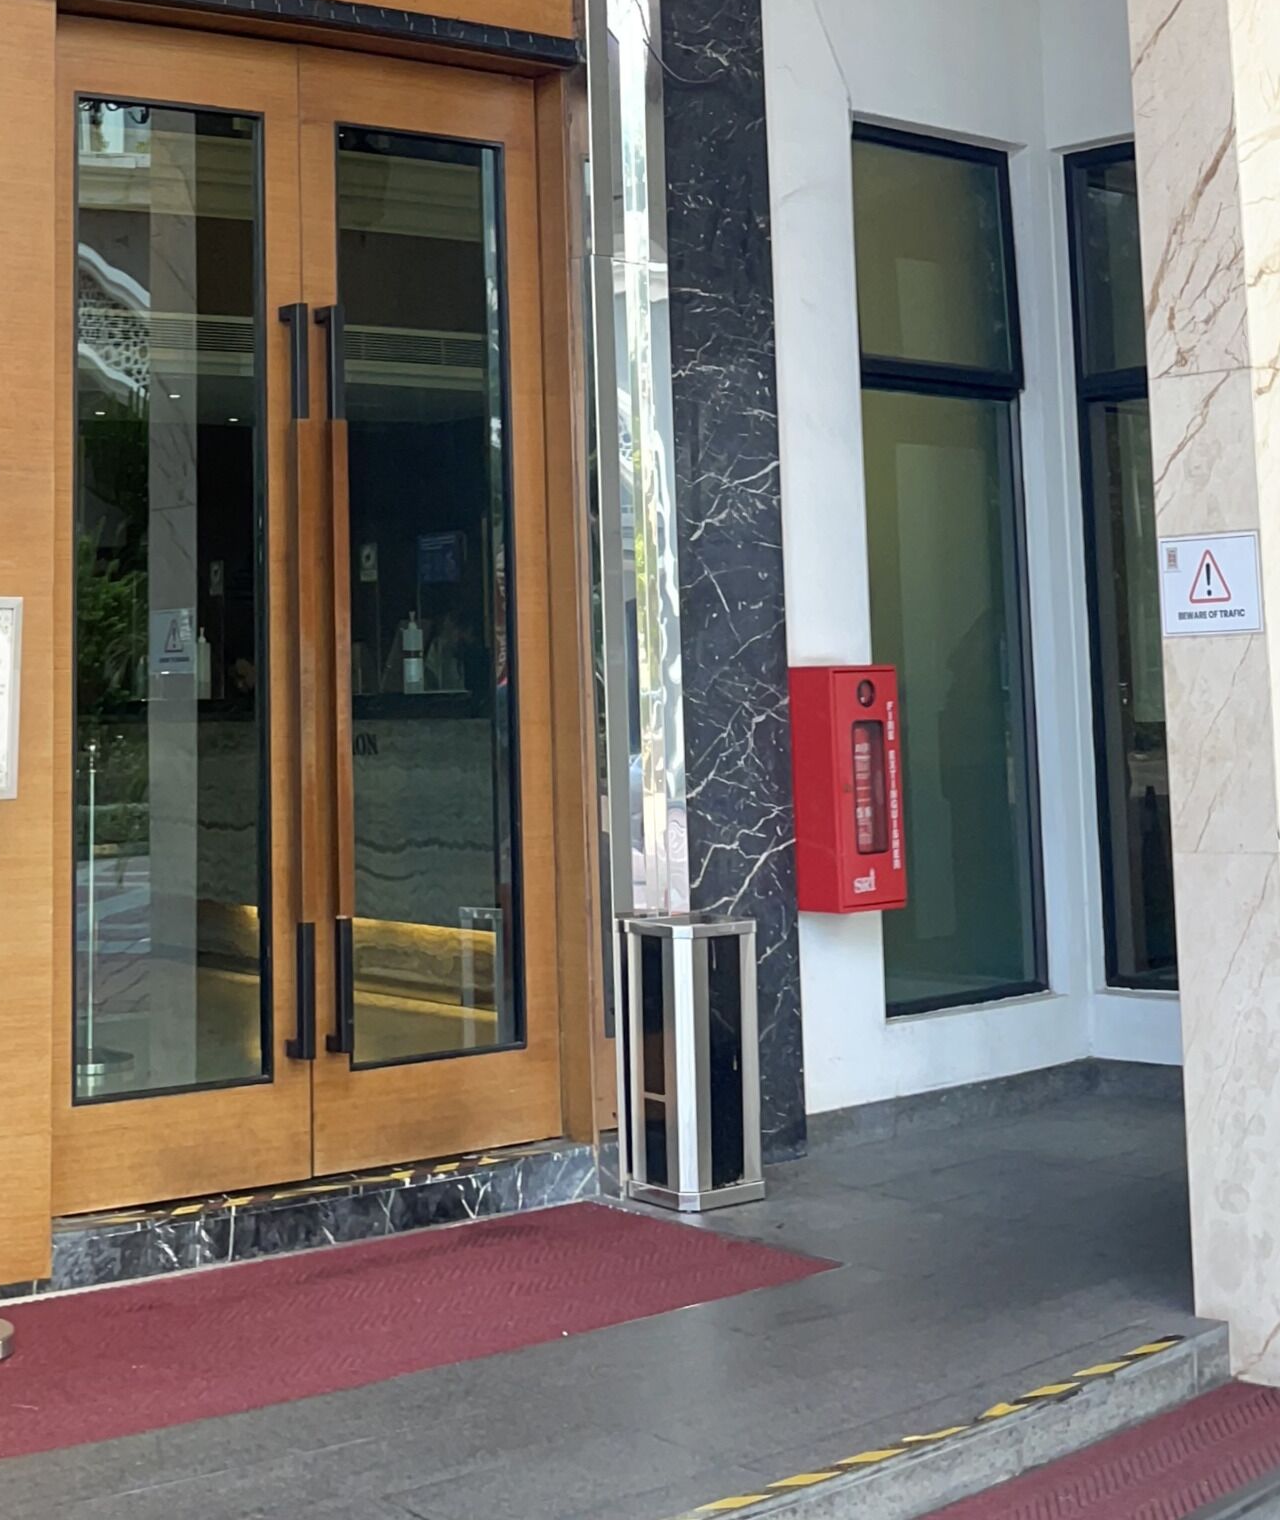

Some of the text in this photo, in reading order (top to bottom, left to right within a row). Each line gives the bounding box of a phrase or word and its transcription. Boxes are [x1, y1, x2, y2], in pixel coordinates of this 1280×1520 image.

[1178, 609, 1245, 620] BEWARE OF TRAFIC
[887, 701, 895, 740] FIRE
